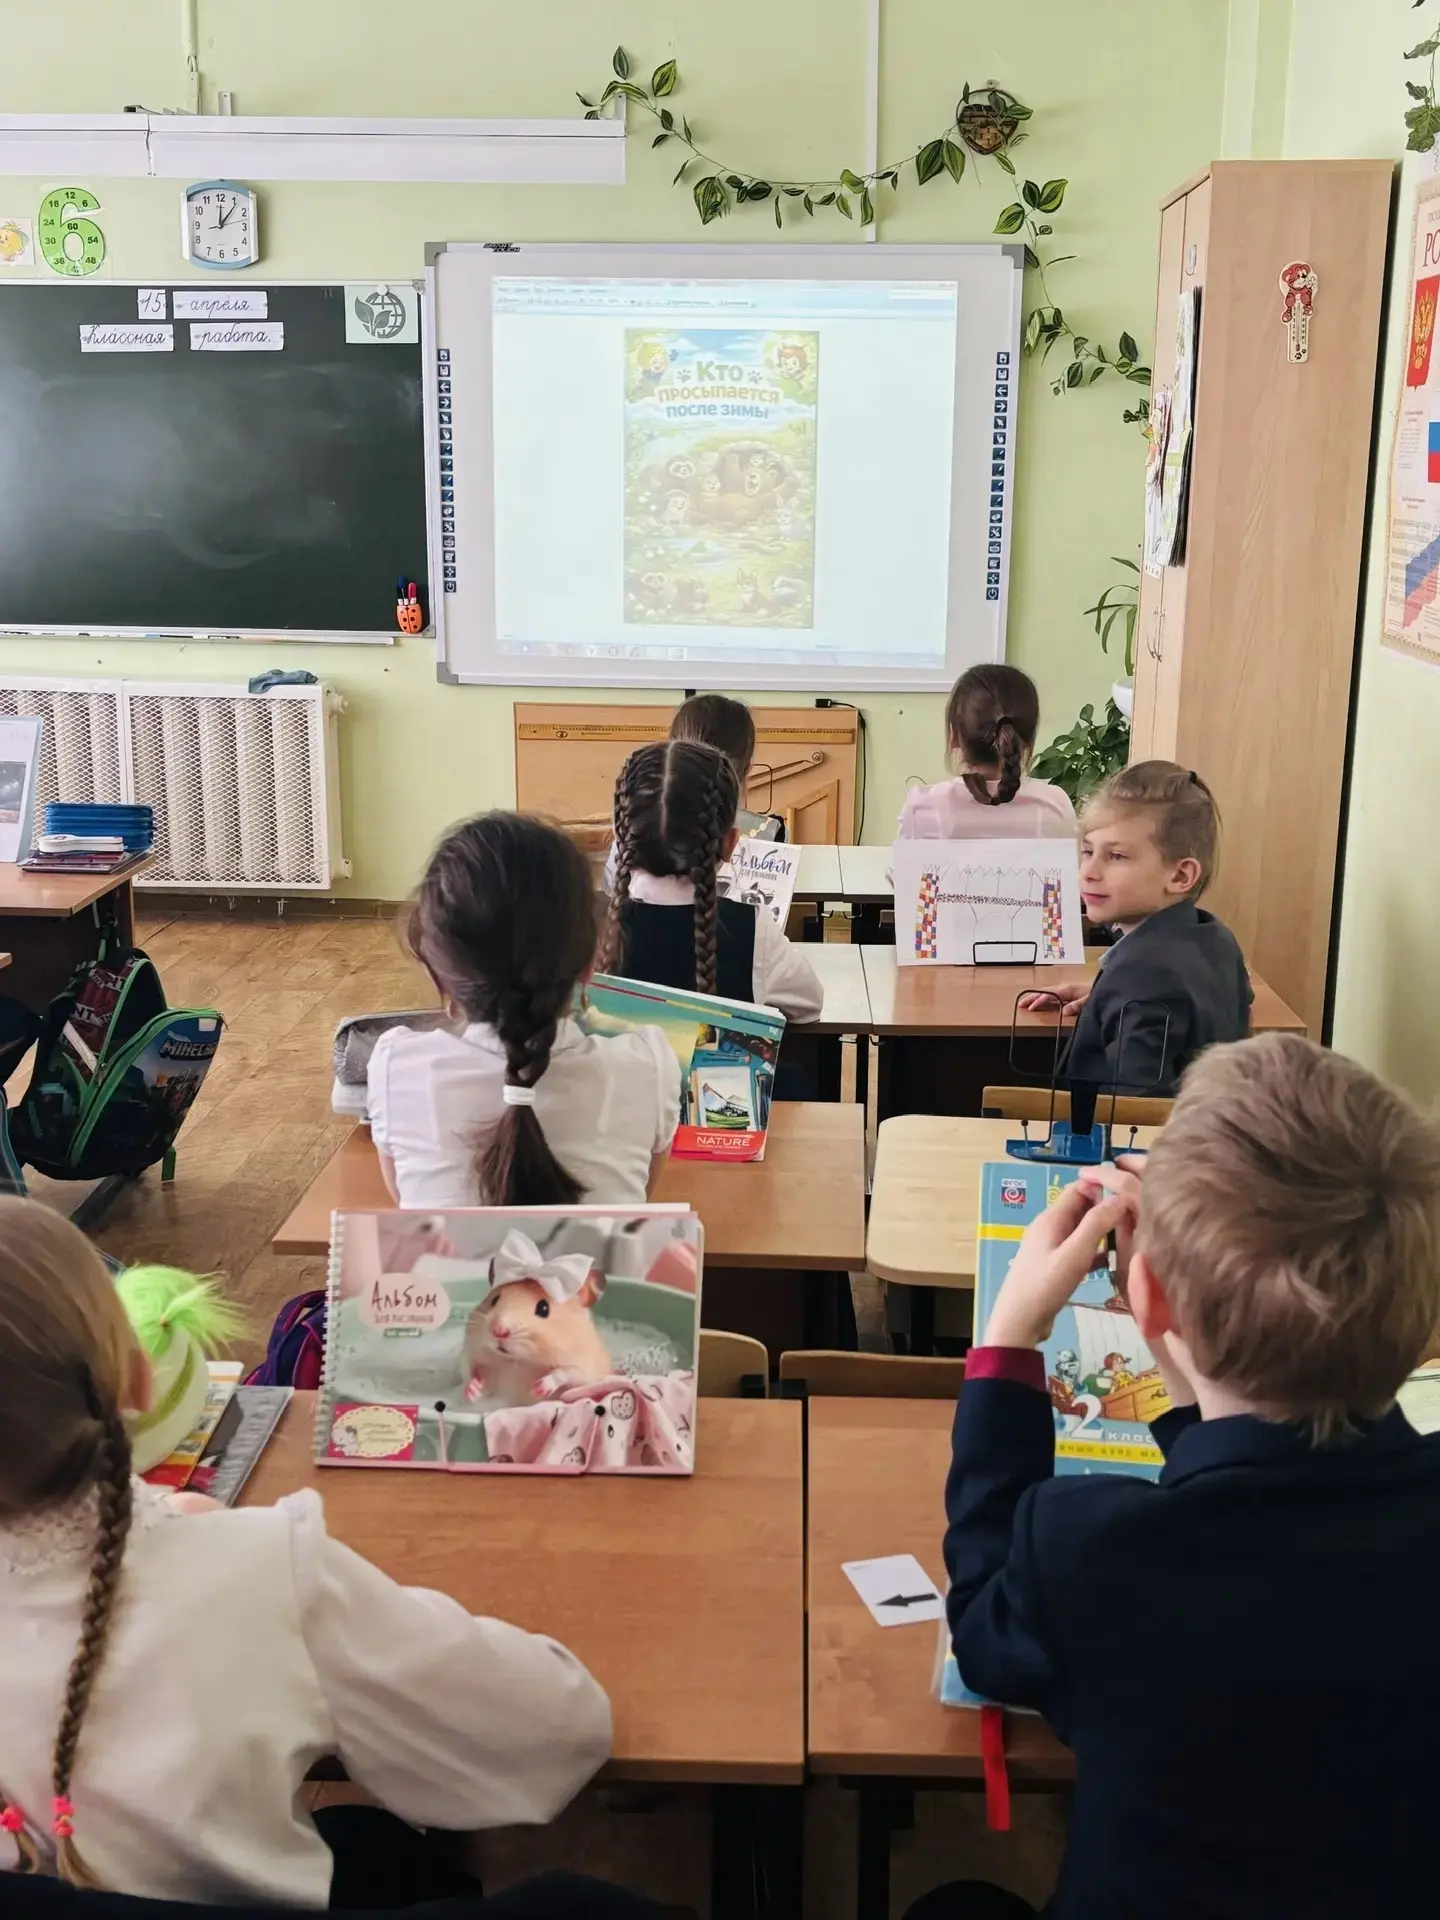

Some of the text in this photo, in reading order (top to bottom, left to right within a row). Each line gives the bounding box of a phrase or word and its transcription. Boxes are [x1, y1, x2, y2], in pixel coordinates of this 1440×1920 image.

[64, 191, 76, 199] 12
[202, 195, 211, 204] 11
[215, 193, 226, 203] 12
[48, 200, 60, 208] 18
[81, 199, 88, 207] 6
[231, 196, 237, 206] 1
[194, 205, 204, 216] 10
[241, 207, 247, 217] 2
[43, 218, 55, 226] 24
[67, 222, 79, 230] 60
[194, 221, 201, 230] 9
[241, 222, 248, 232] 3
[45, 237, 56, 245] 30
[87, 236, 99, 244] 54
[195, 235, 201, 244] 8
[241, 237, 248, 245] 4
[206, 246, 212, 256] 7
[219, 249, 225, 259] 6
[232, 247, 239, 257] 5
[53, 257, 65, 265] 36
[85, 256, 97, 264] 48
[143, 292, 166, 313] 15
[199, 322, 272, 350] работа.
[696, 1135, 751, 1147] NATURE
[1070, 1393, 1156, 1444] 2 клас
